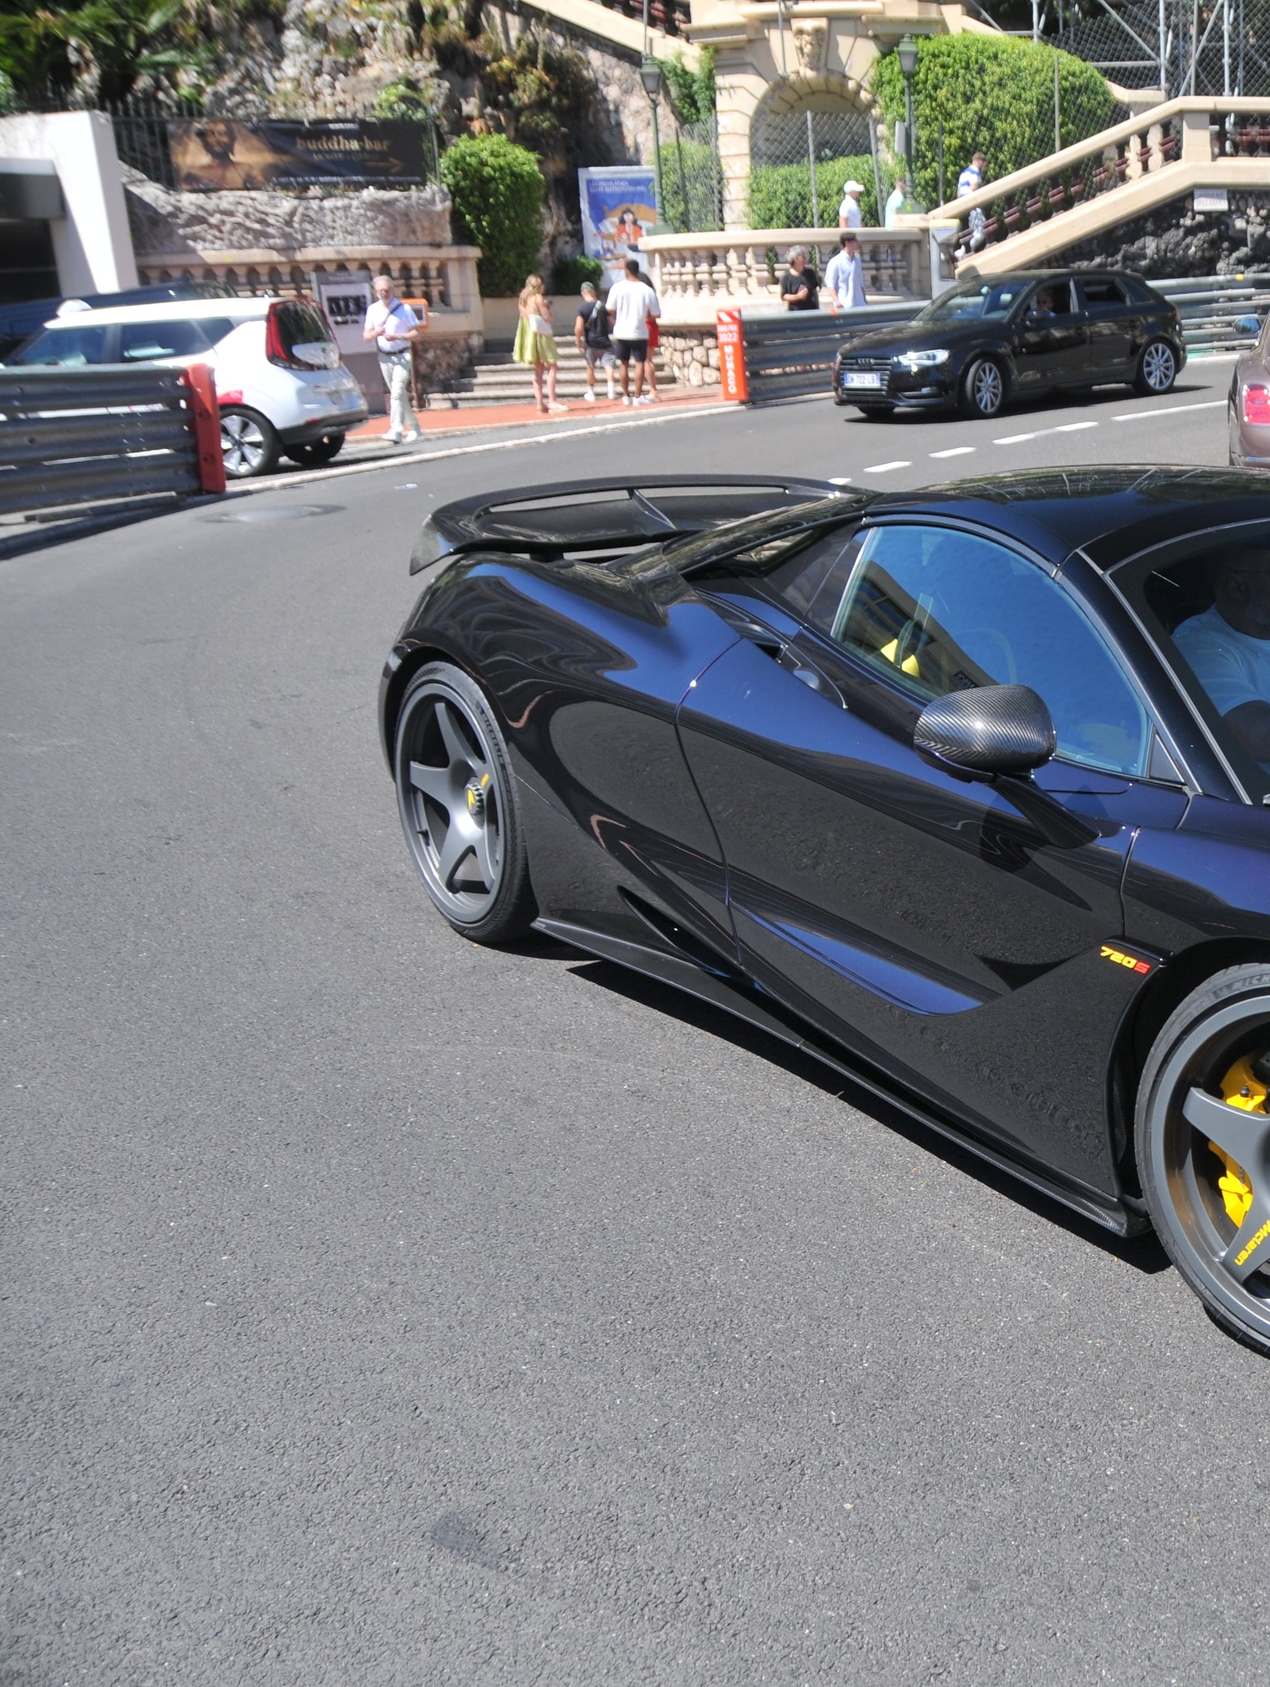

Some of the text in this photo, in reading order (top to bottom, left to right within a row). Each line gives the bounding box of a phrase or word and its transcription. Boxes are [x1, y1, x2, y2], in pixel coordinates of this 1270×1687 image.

[718, 332, 738, 343] 2022
[723, 344, 738, 395] MONACO
[1100, 945, 1151, 975] 720S
